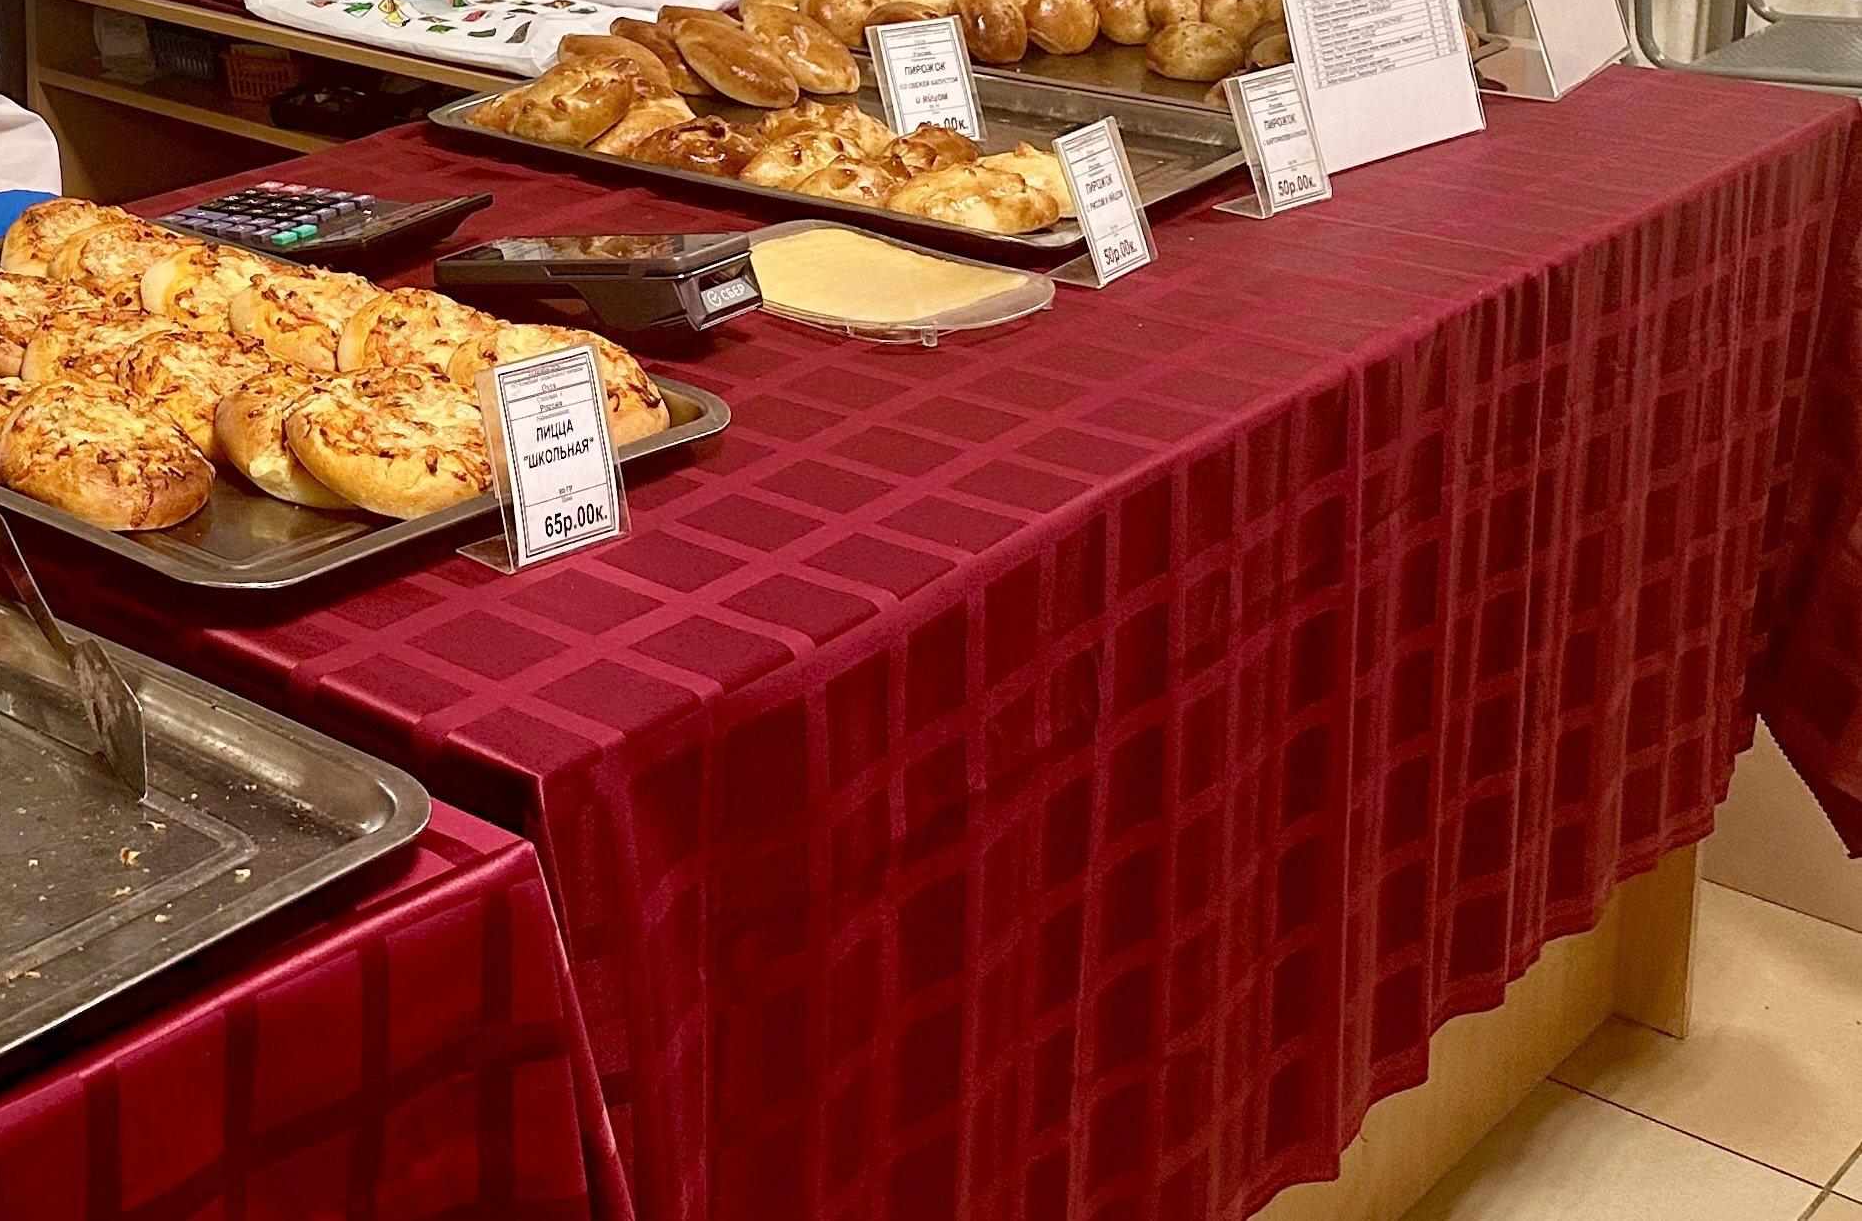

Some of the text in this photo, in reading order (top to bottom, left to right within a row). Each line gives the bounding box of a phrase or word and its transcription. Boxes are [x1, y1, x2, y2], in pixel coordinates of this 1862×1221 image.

[904, 62, 946, 76] ПИРОЖОК
[1278, 174, 1317, 197] 50р.00к.
[1103, 239, 1138, 266] 50р.00к.
[720, 284, 745, 300] СБЕР
[536, 418, 574, 442] ПИЦЦА
[523, 436, 594, 469] "ШКОЛЬНАЯ"
[544, 503, 608, 538] 65р.00к.
